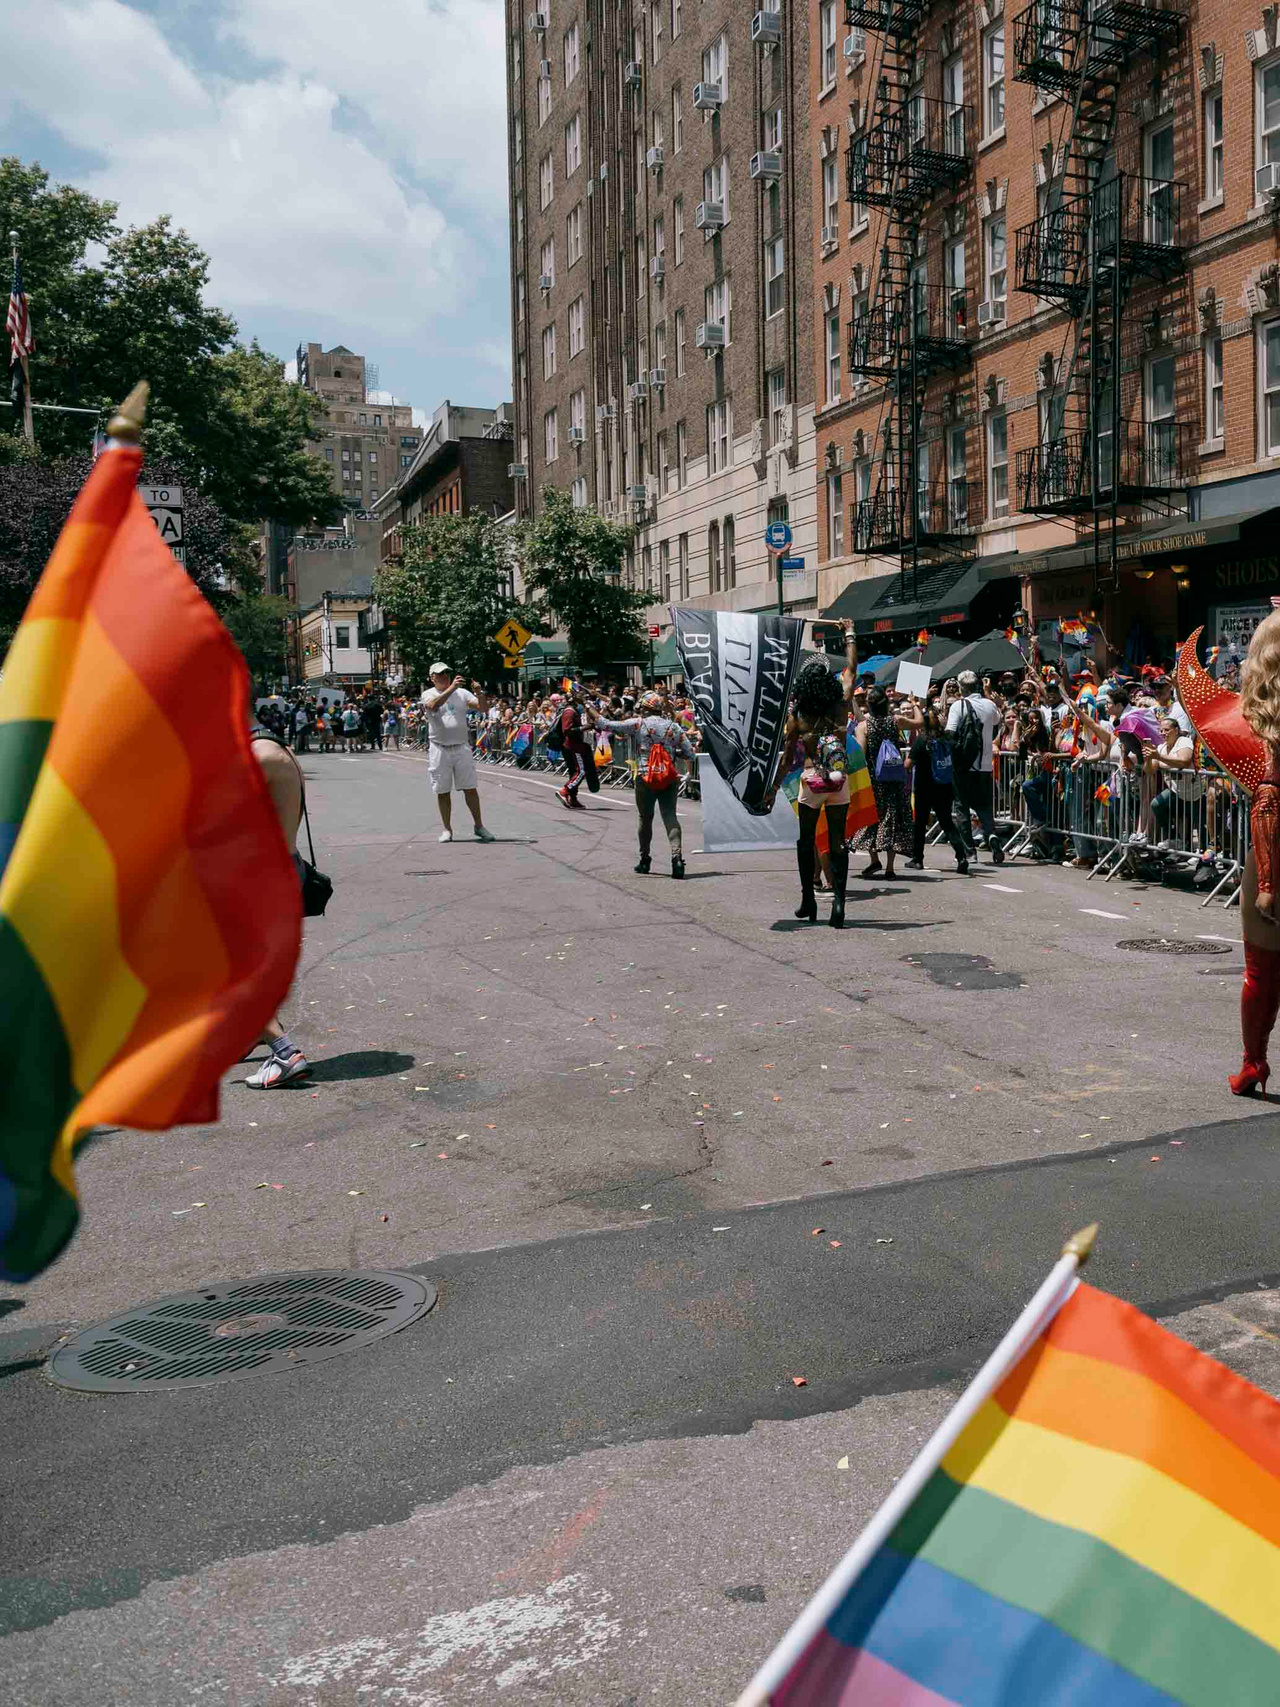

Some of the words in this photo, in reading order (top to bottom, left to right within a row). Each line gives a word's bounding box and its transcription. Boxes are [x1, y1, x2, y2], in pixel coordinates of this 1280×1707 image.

[150, 490, 170, 502] TO
[1116, 546, 1127, 557] TEP
[1130, 542, 1140, 555] UP
[1141, 540, 1162, 553] YOUR
[1162, 536, 1182, 550] SHOE
[1184, 532, 1206, 547] GAME
[1216, 556, 1279, 588] SHOES
